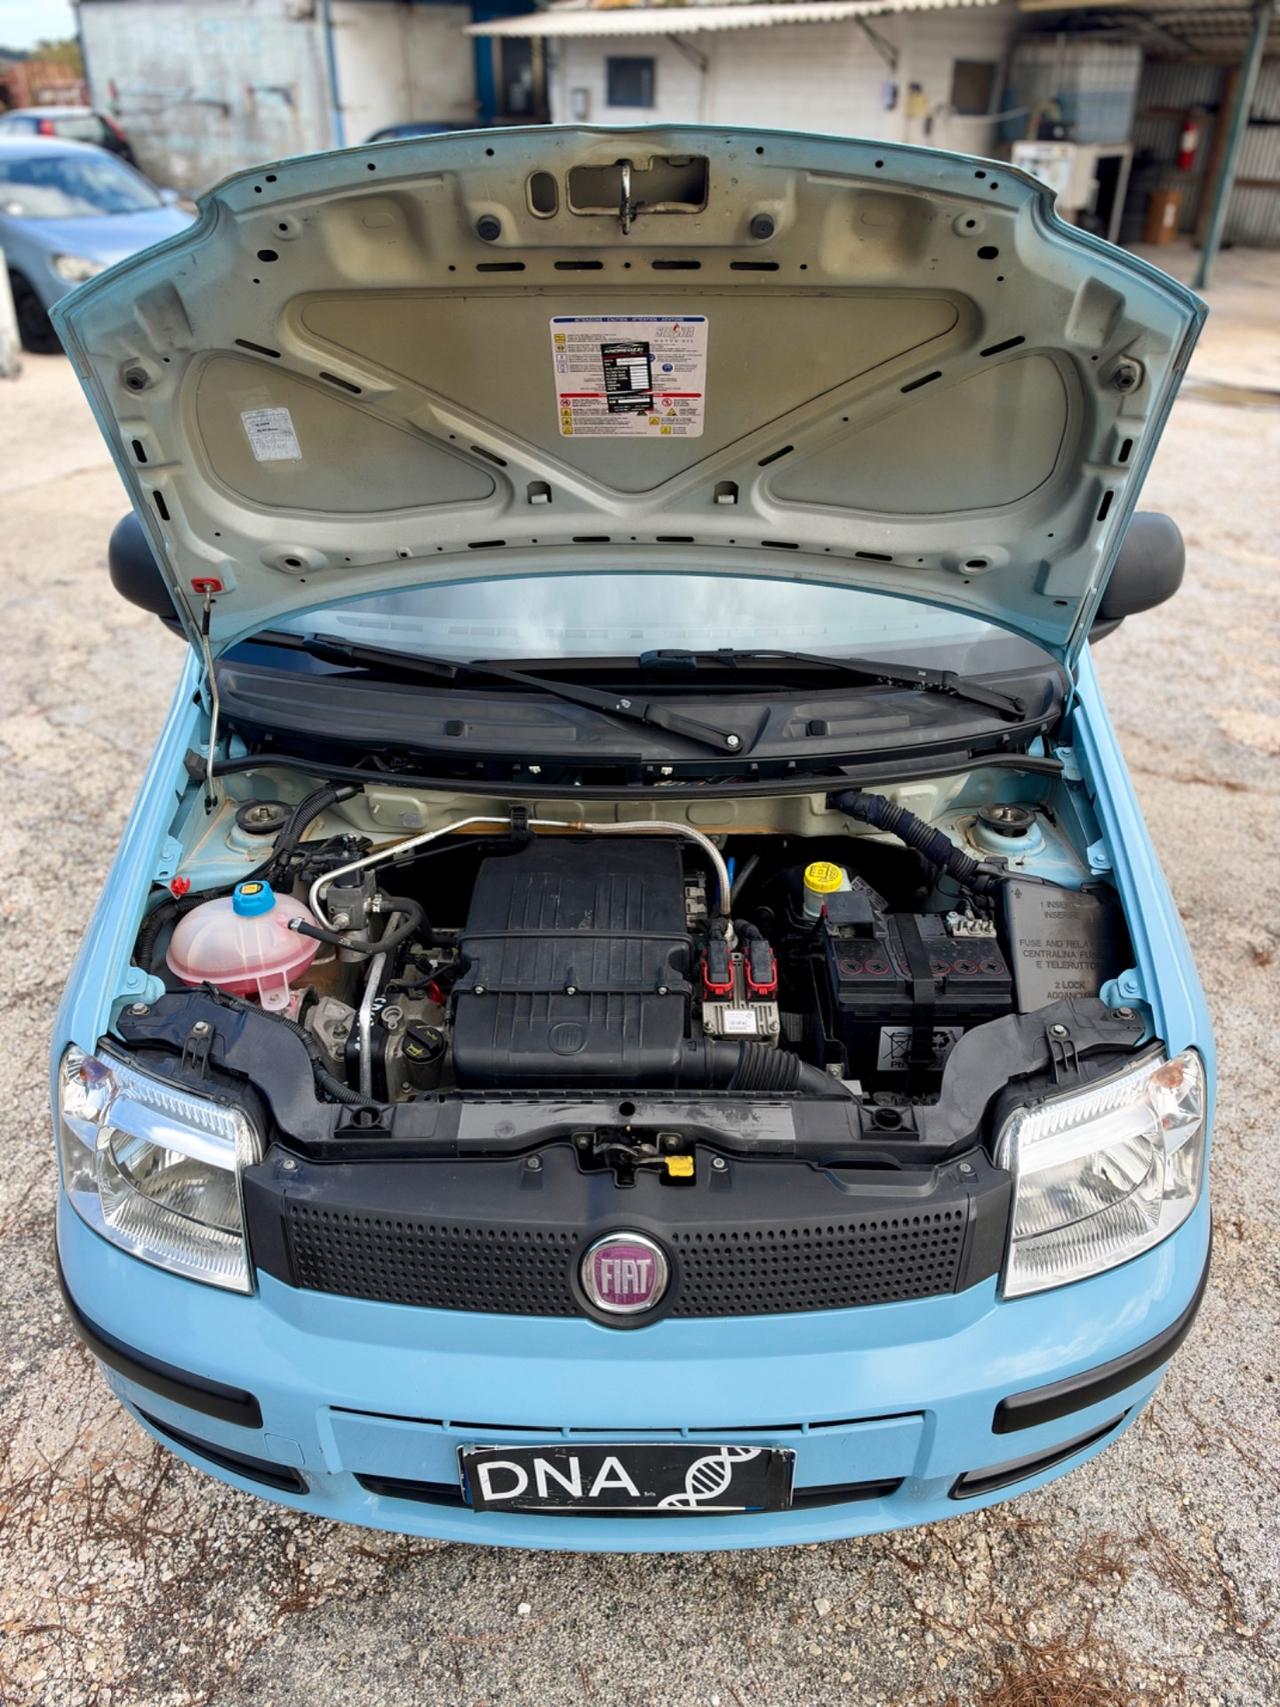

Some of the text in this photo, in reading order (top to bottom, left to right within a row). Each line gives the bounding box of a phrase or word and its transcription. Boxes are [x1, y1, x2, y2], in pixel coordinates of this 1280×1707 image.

[1019, 939, 1042, 948] FUSE
[1046, 940, 1063, 948] AND
[1023, 950, 1077, 959] CENTRALINA
[1036, 961, 1042, 969] E
[1062, 981, 1085, 990] LOCK
[601, 1258, 652, 1294] FIAT
[476, 1456, 641, 1501] DNA
